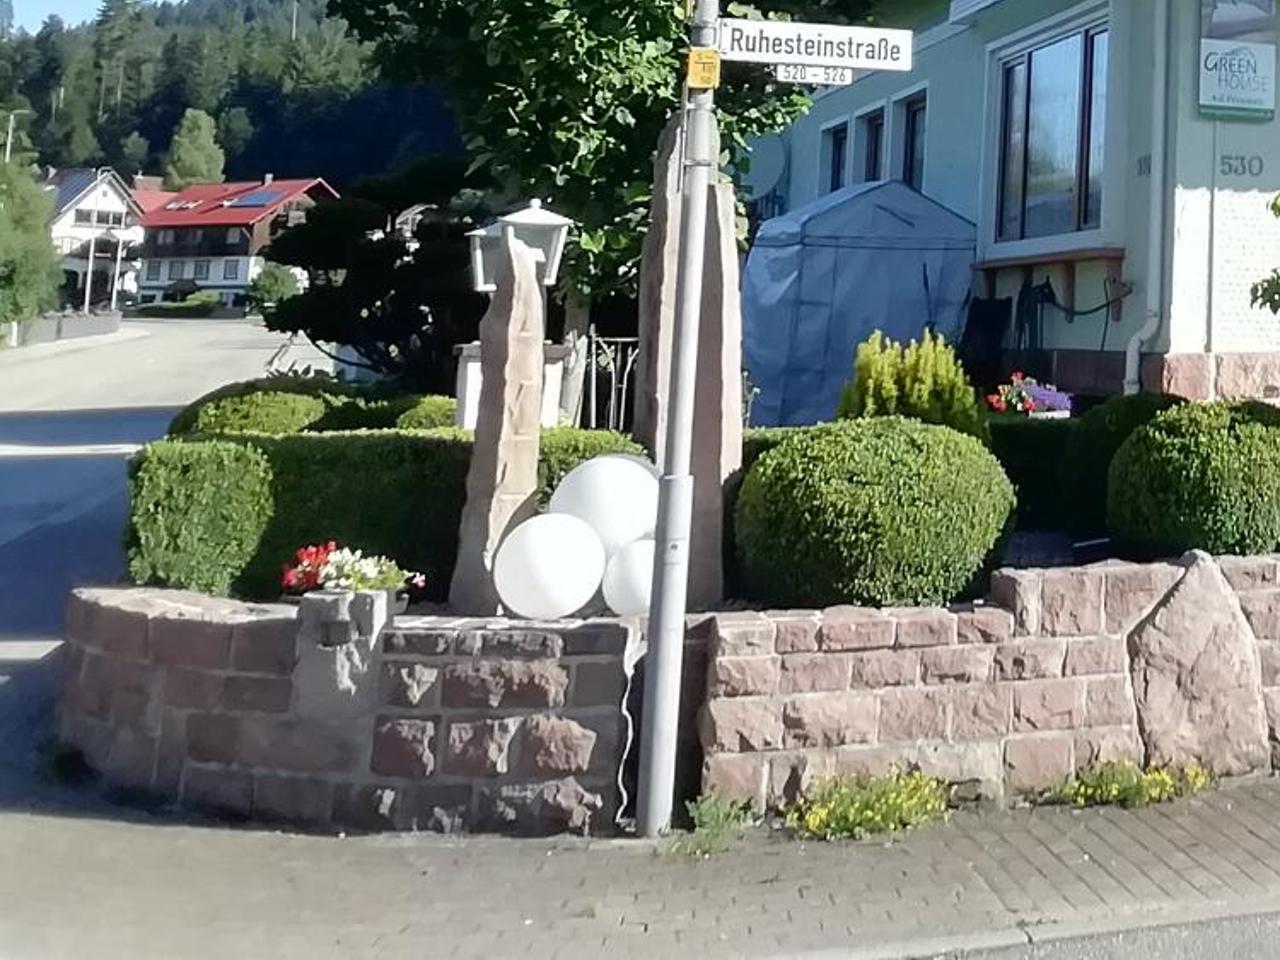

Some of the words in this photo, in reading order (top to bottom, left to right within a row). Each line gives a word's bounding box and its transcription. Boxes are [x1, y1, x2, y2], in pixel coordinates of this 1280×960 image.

[730, 27, 901, 62] Ruhesteinstraße
[783, 65, 806, 80] 520
[1204, 51, 1257, 75] GREEN
[1218, 73, 1270, 92] HOUSE
[1219, 154, 1264, 177] 530
